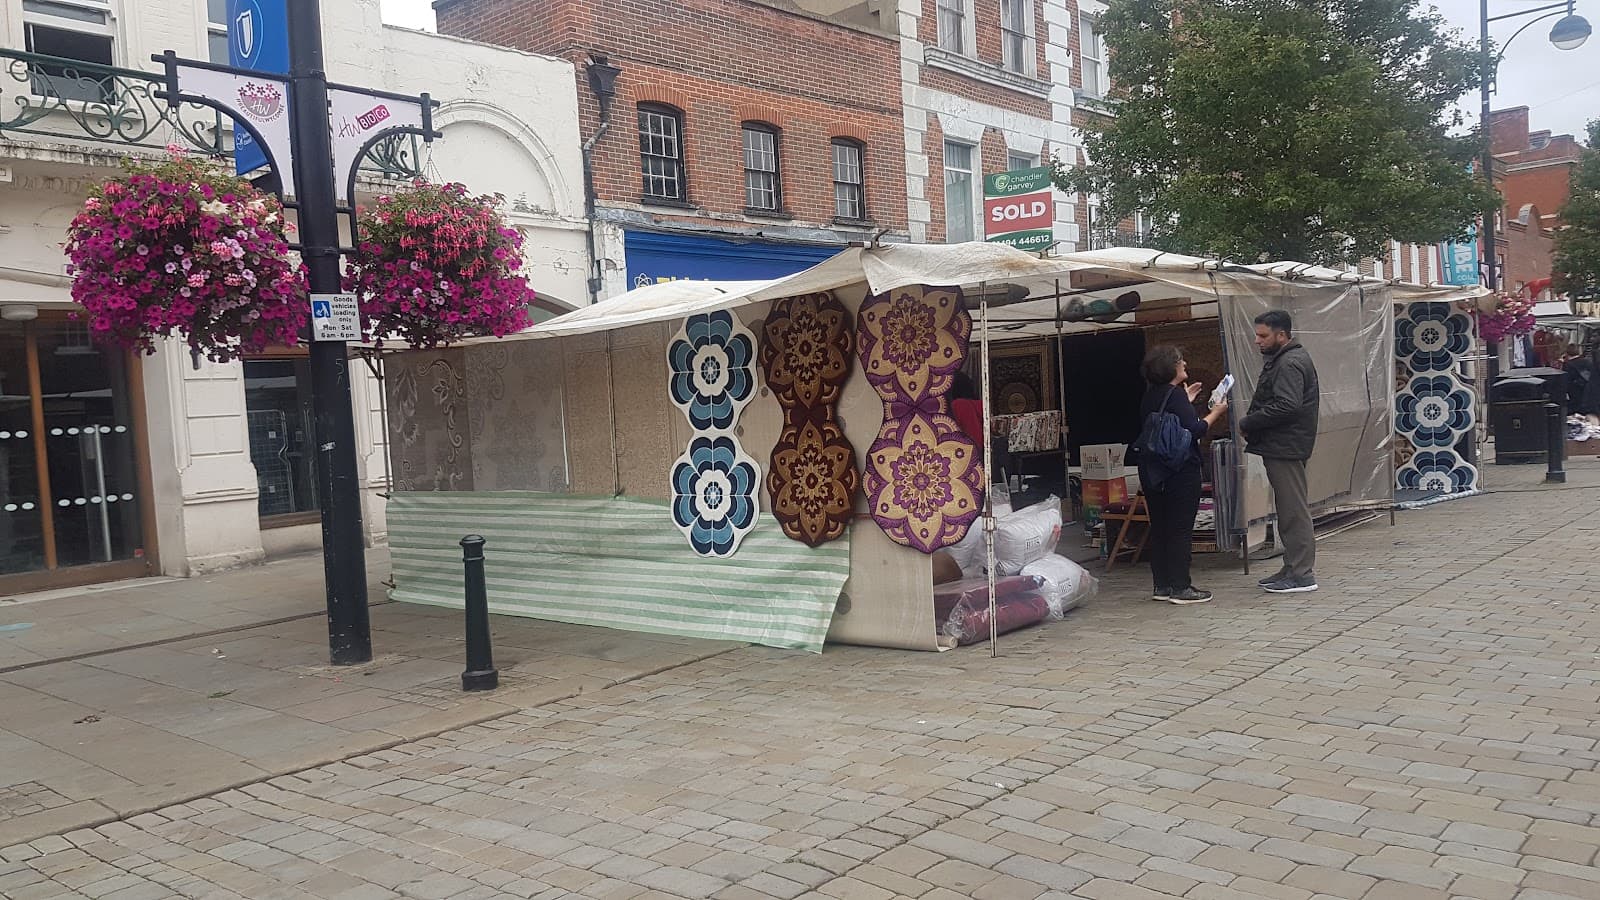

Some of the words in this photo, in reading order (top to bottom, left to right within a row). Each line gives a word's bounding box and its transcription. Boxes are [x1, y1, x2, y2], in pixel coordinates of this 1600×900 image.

[338, 115, 361, 138] HW
[1010, 172, 1043, 183] chandler
[1007, 181, 1034, 192] garvey
[991, 201, 1047, 222] SOLD
